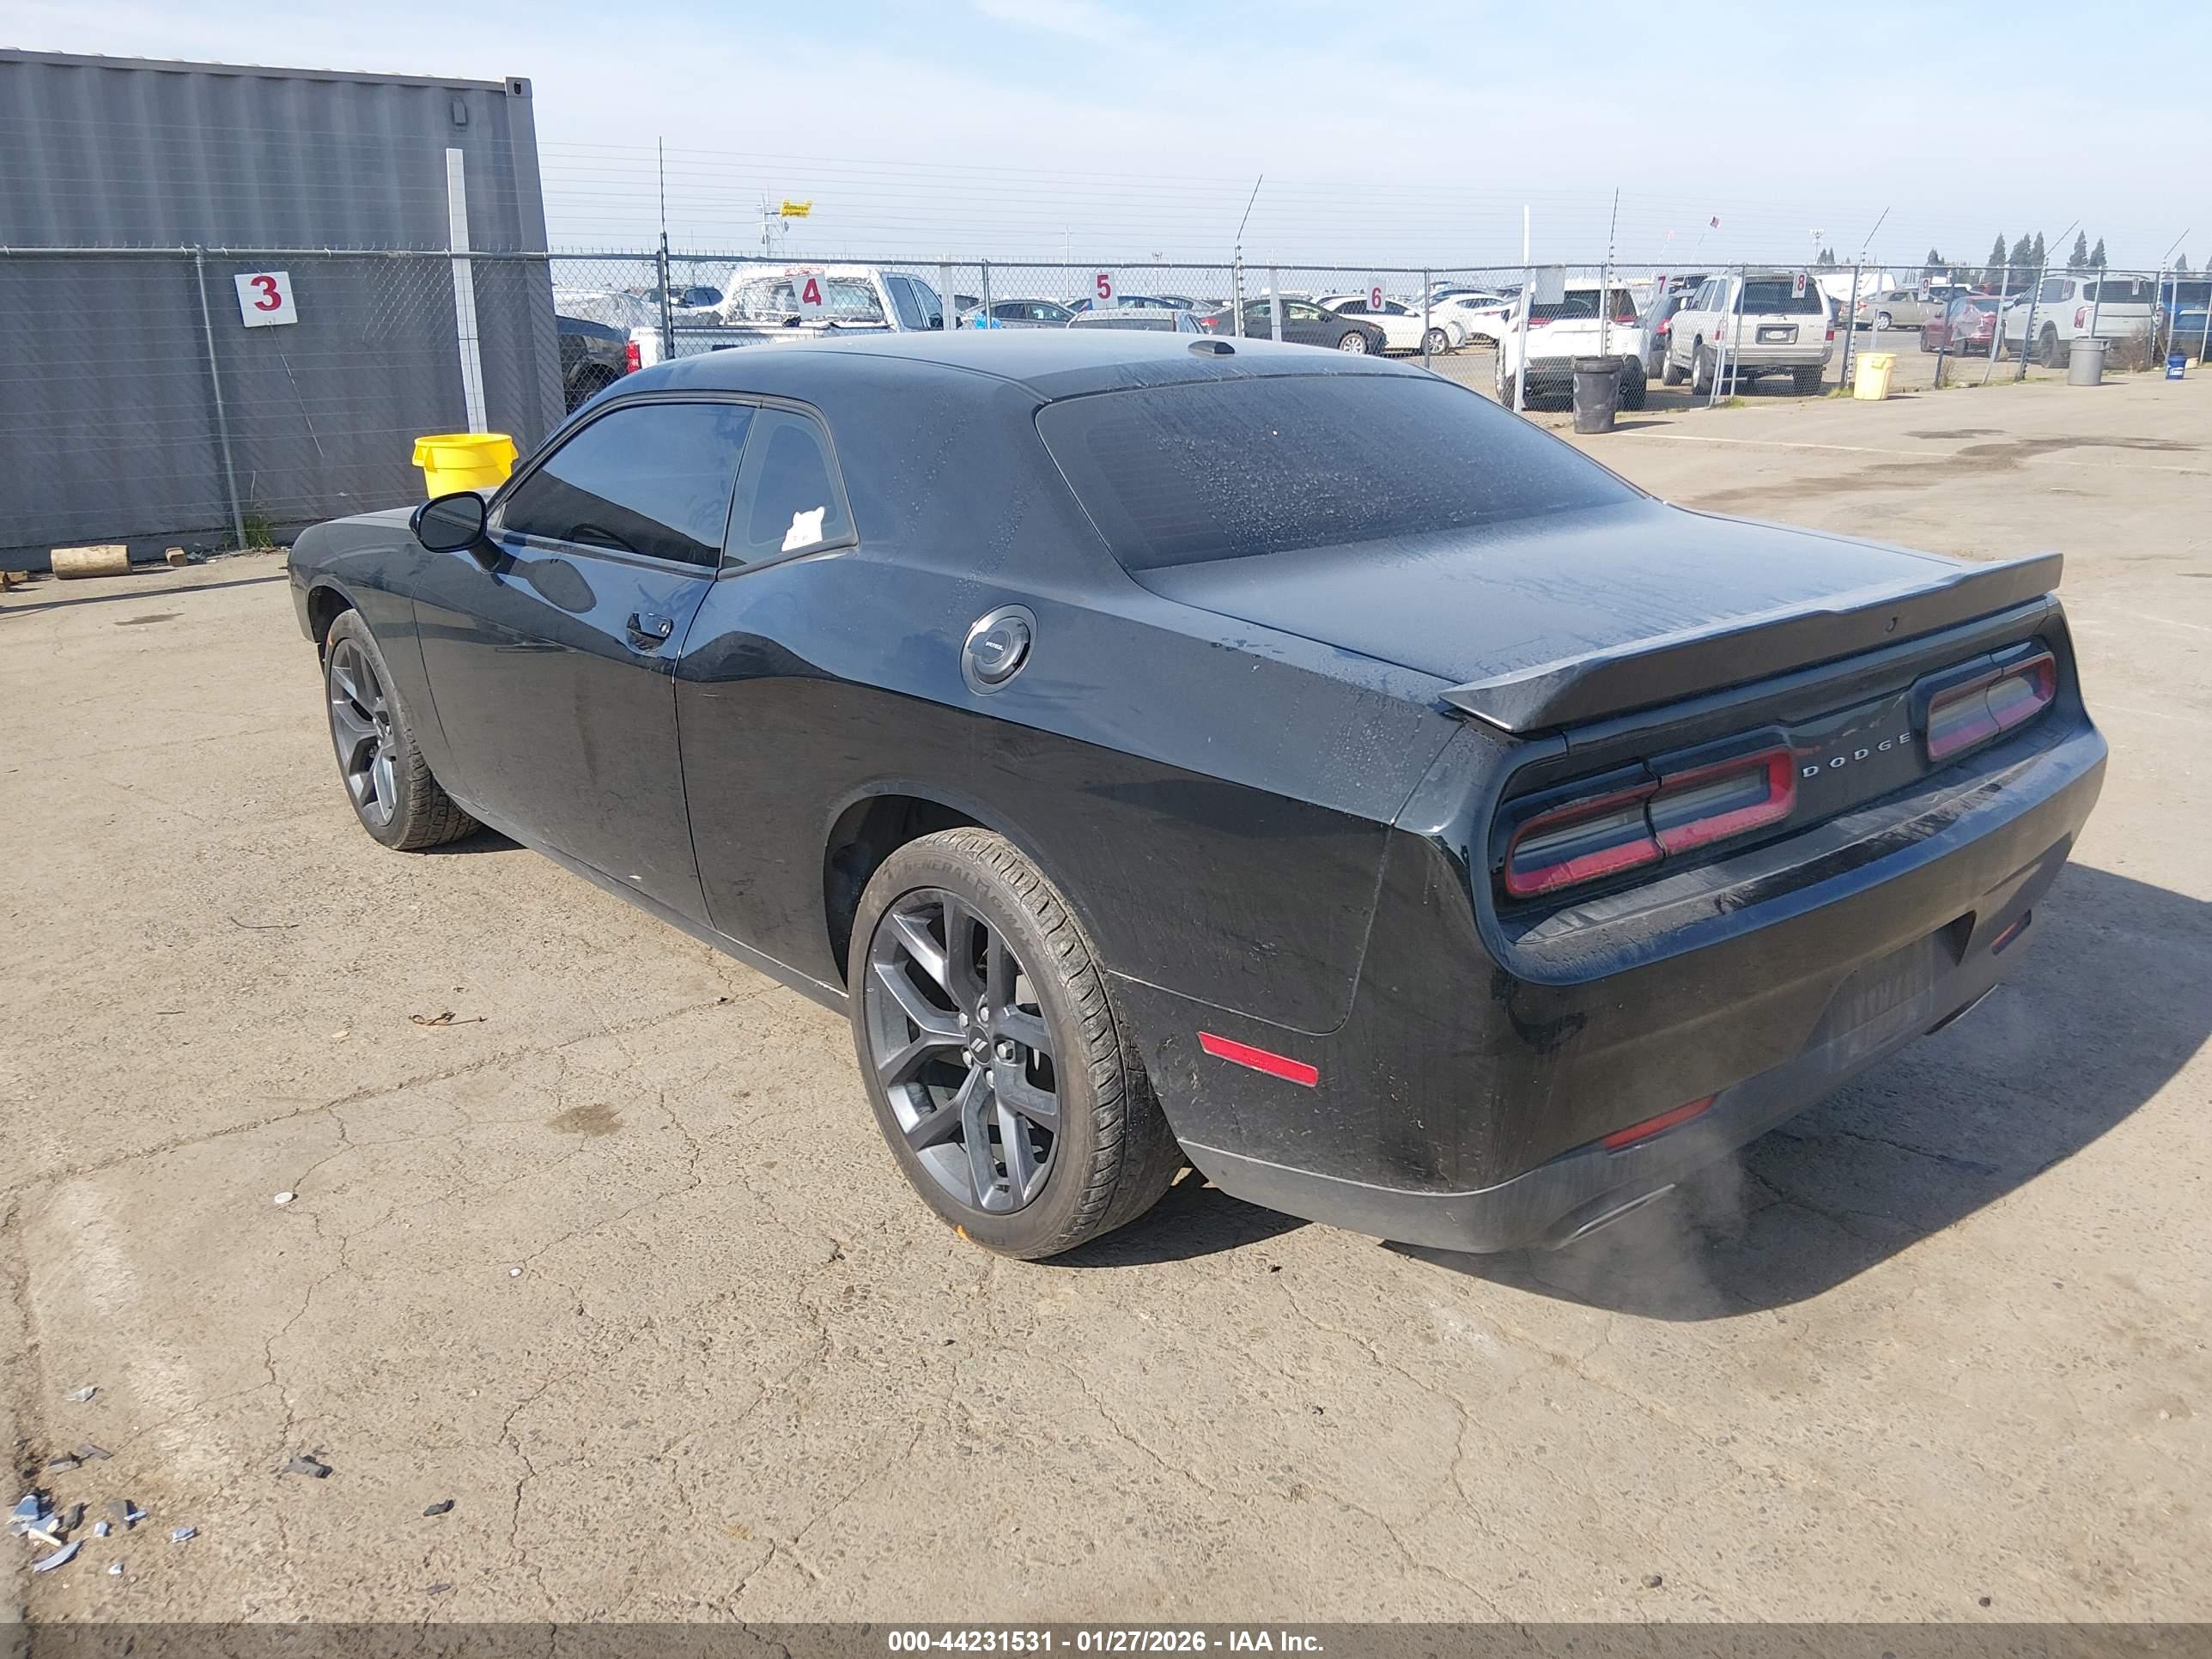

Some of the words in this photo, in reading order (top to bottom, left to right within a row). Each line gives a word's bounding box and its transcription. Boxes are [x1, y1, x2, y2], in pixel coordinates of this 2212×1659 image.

[250, 275, 283, 311] 3
[802, 277, 822, 306] 4
[1097, 274, 1111, 299] 5
[1657, 276, 1666, 295] 7
[1797, 274, 1805, 291] 8
[1371, 287, 1382, 309] 6
[1802, 732, 1911, 778] DODGE
